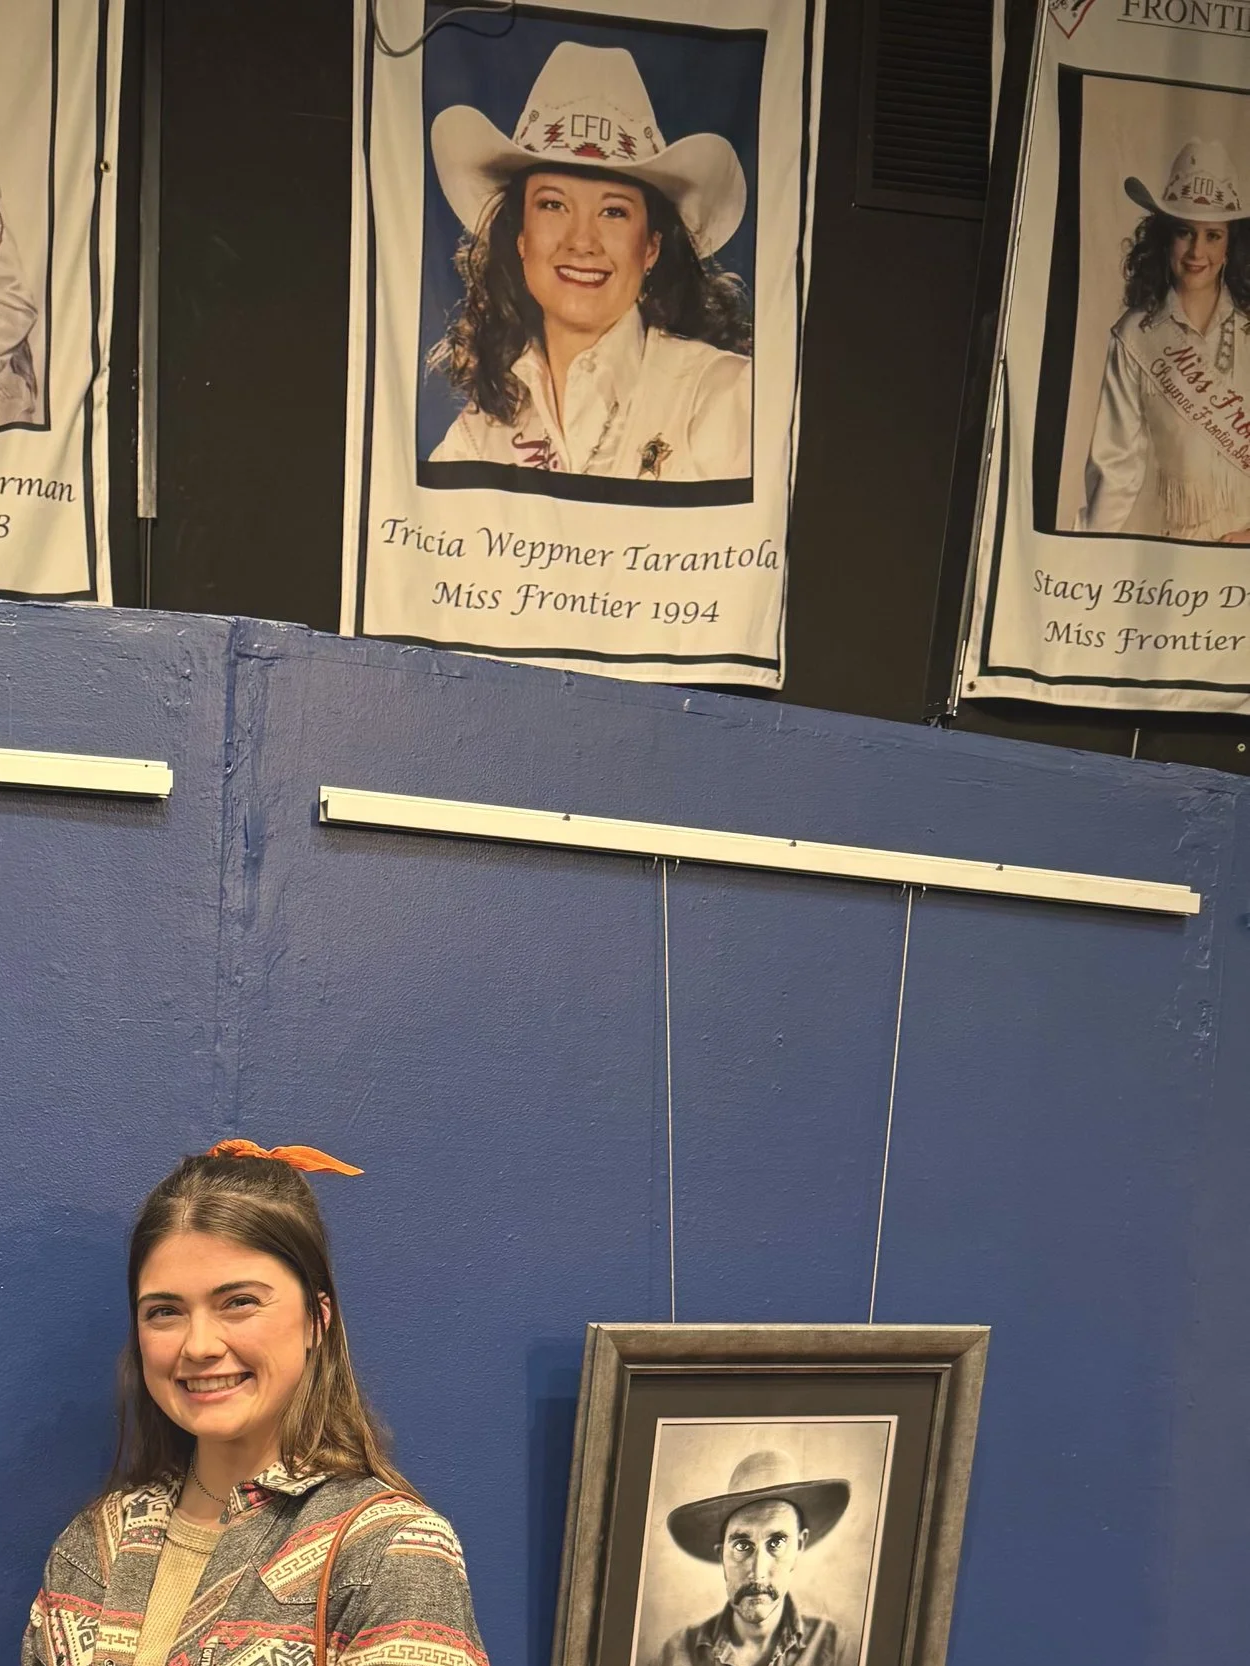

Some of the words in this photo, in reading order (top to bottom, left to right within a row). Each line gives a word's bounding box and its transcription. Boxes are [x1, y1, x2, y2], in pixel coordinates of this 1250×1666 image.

[1122, 0, 1250, 32] FRONTI
[571, 114, 611, 141] CFD
[1163, 346, 1213, 393] Miss
[1151, 358, 1195, 413] Cheyenne
[1192, 406, 1235, 452] Frontier
[381, 517, 466, 558] Tricia
[477, 527, 614, 570] Weppner
[622, 539, 779, 572] Tarantola
[432, 581, 502, 610] Miss
[510, 583, 641, 619] Frontier
[650, 600, 719, 624] 1994
[1034, 569, 1103, 611] Stacy
[1113, 578, 1209, 617] Bishop
[1219, 585, 1250, 608] D
[1044, 620, 1106, 648] Miss
[1114, 628, 1246, 655] Frontier
